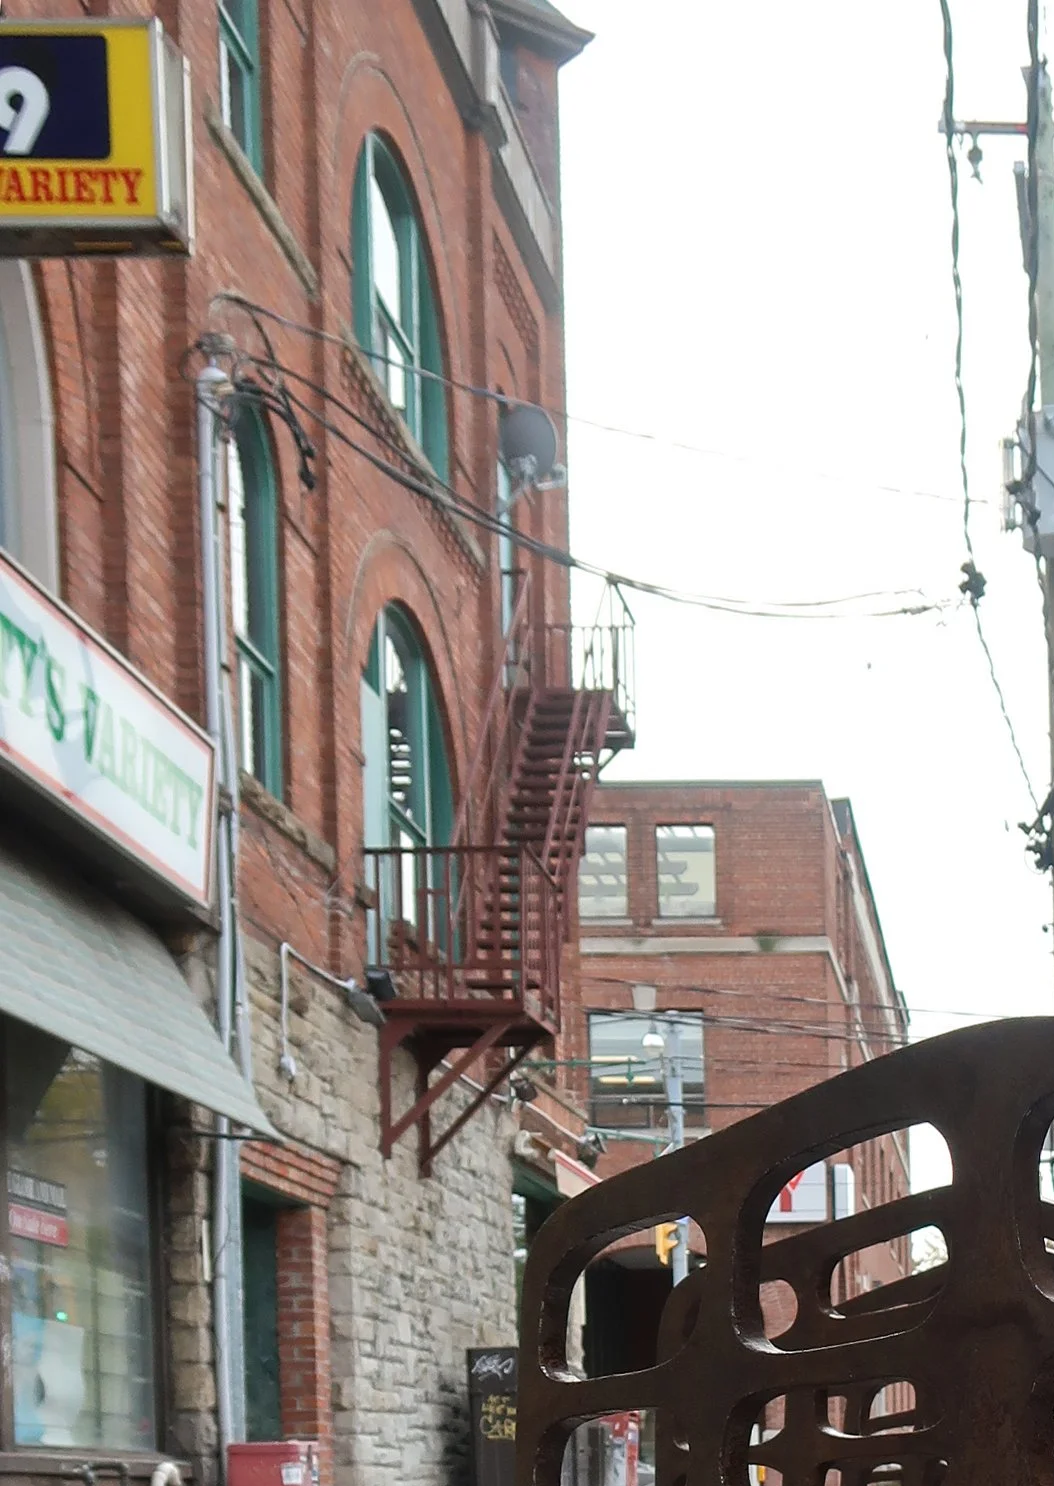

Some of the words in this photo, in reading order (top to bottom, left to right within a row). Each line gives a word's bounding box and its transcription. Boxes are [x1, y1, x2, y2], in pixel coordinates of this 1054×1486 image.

[0, 66, 50, 155] 9
[0, 167, 142, 204] ARIETY
[79, 681, 206, 852] VARIETY
